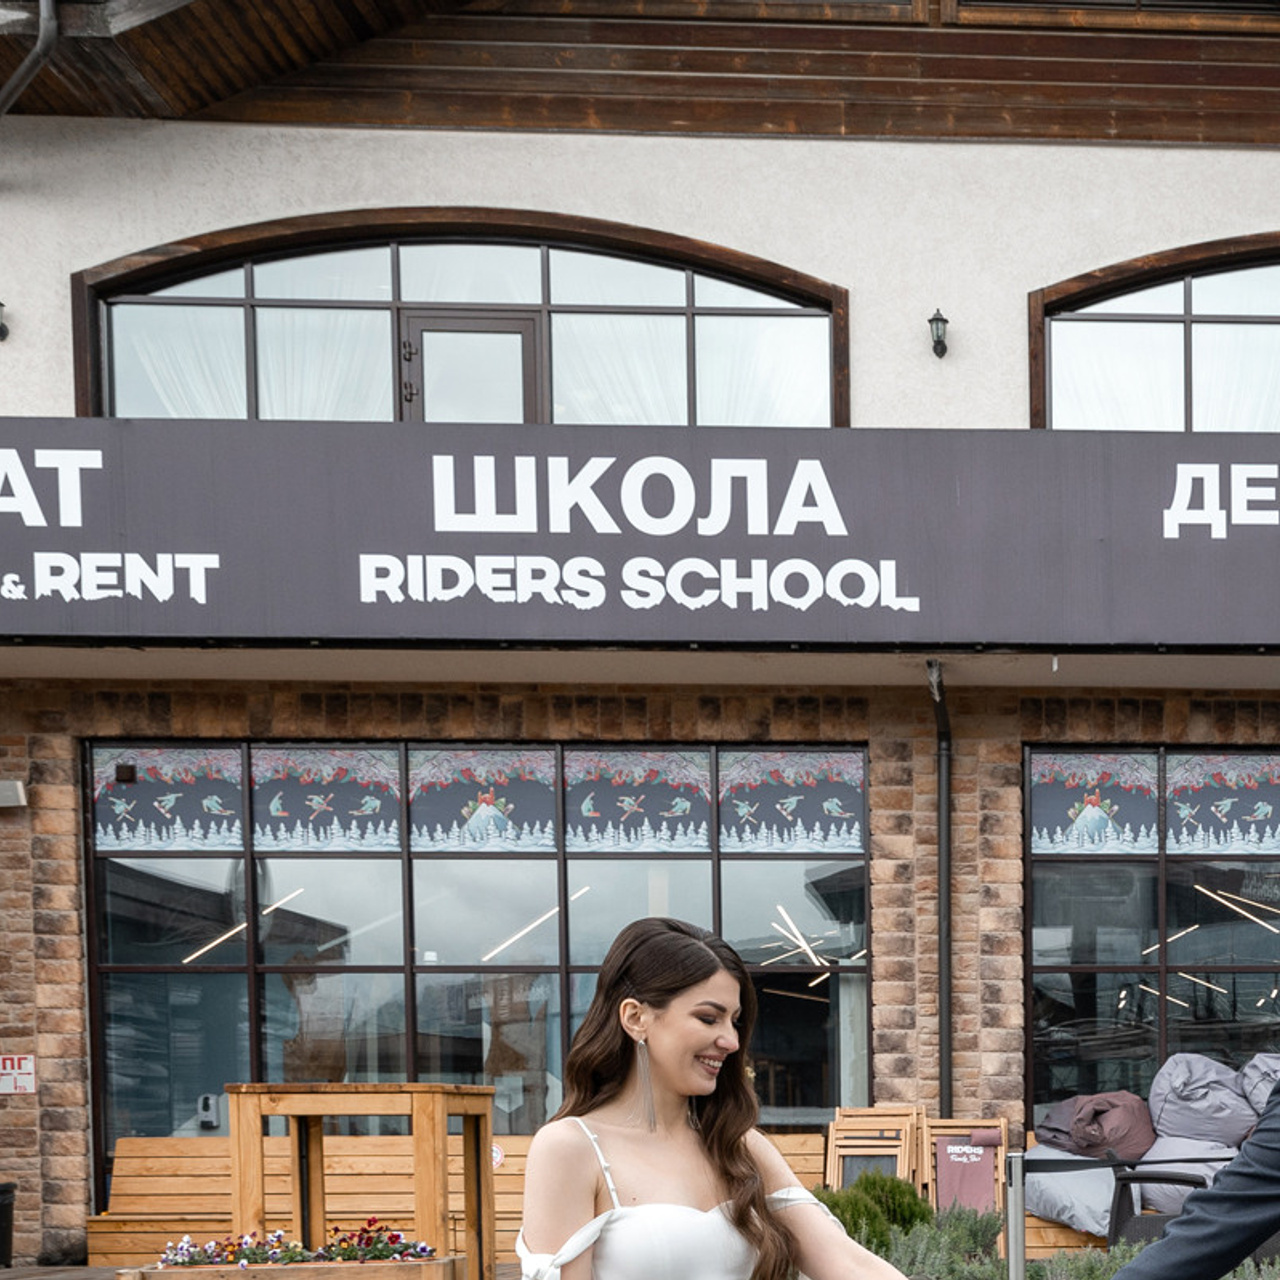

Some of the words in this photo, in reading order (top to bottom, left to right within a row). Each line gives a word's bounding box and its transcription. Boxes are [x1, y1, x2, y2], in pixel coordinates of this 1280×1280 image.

[433, 455, 848, 536] ШКОЛА
[360, 554, 606, 610] RIDERS
[621, 557, 920, 611] SCHOOL
